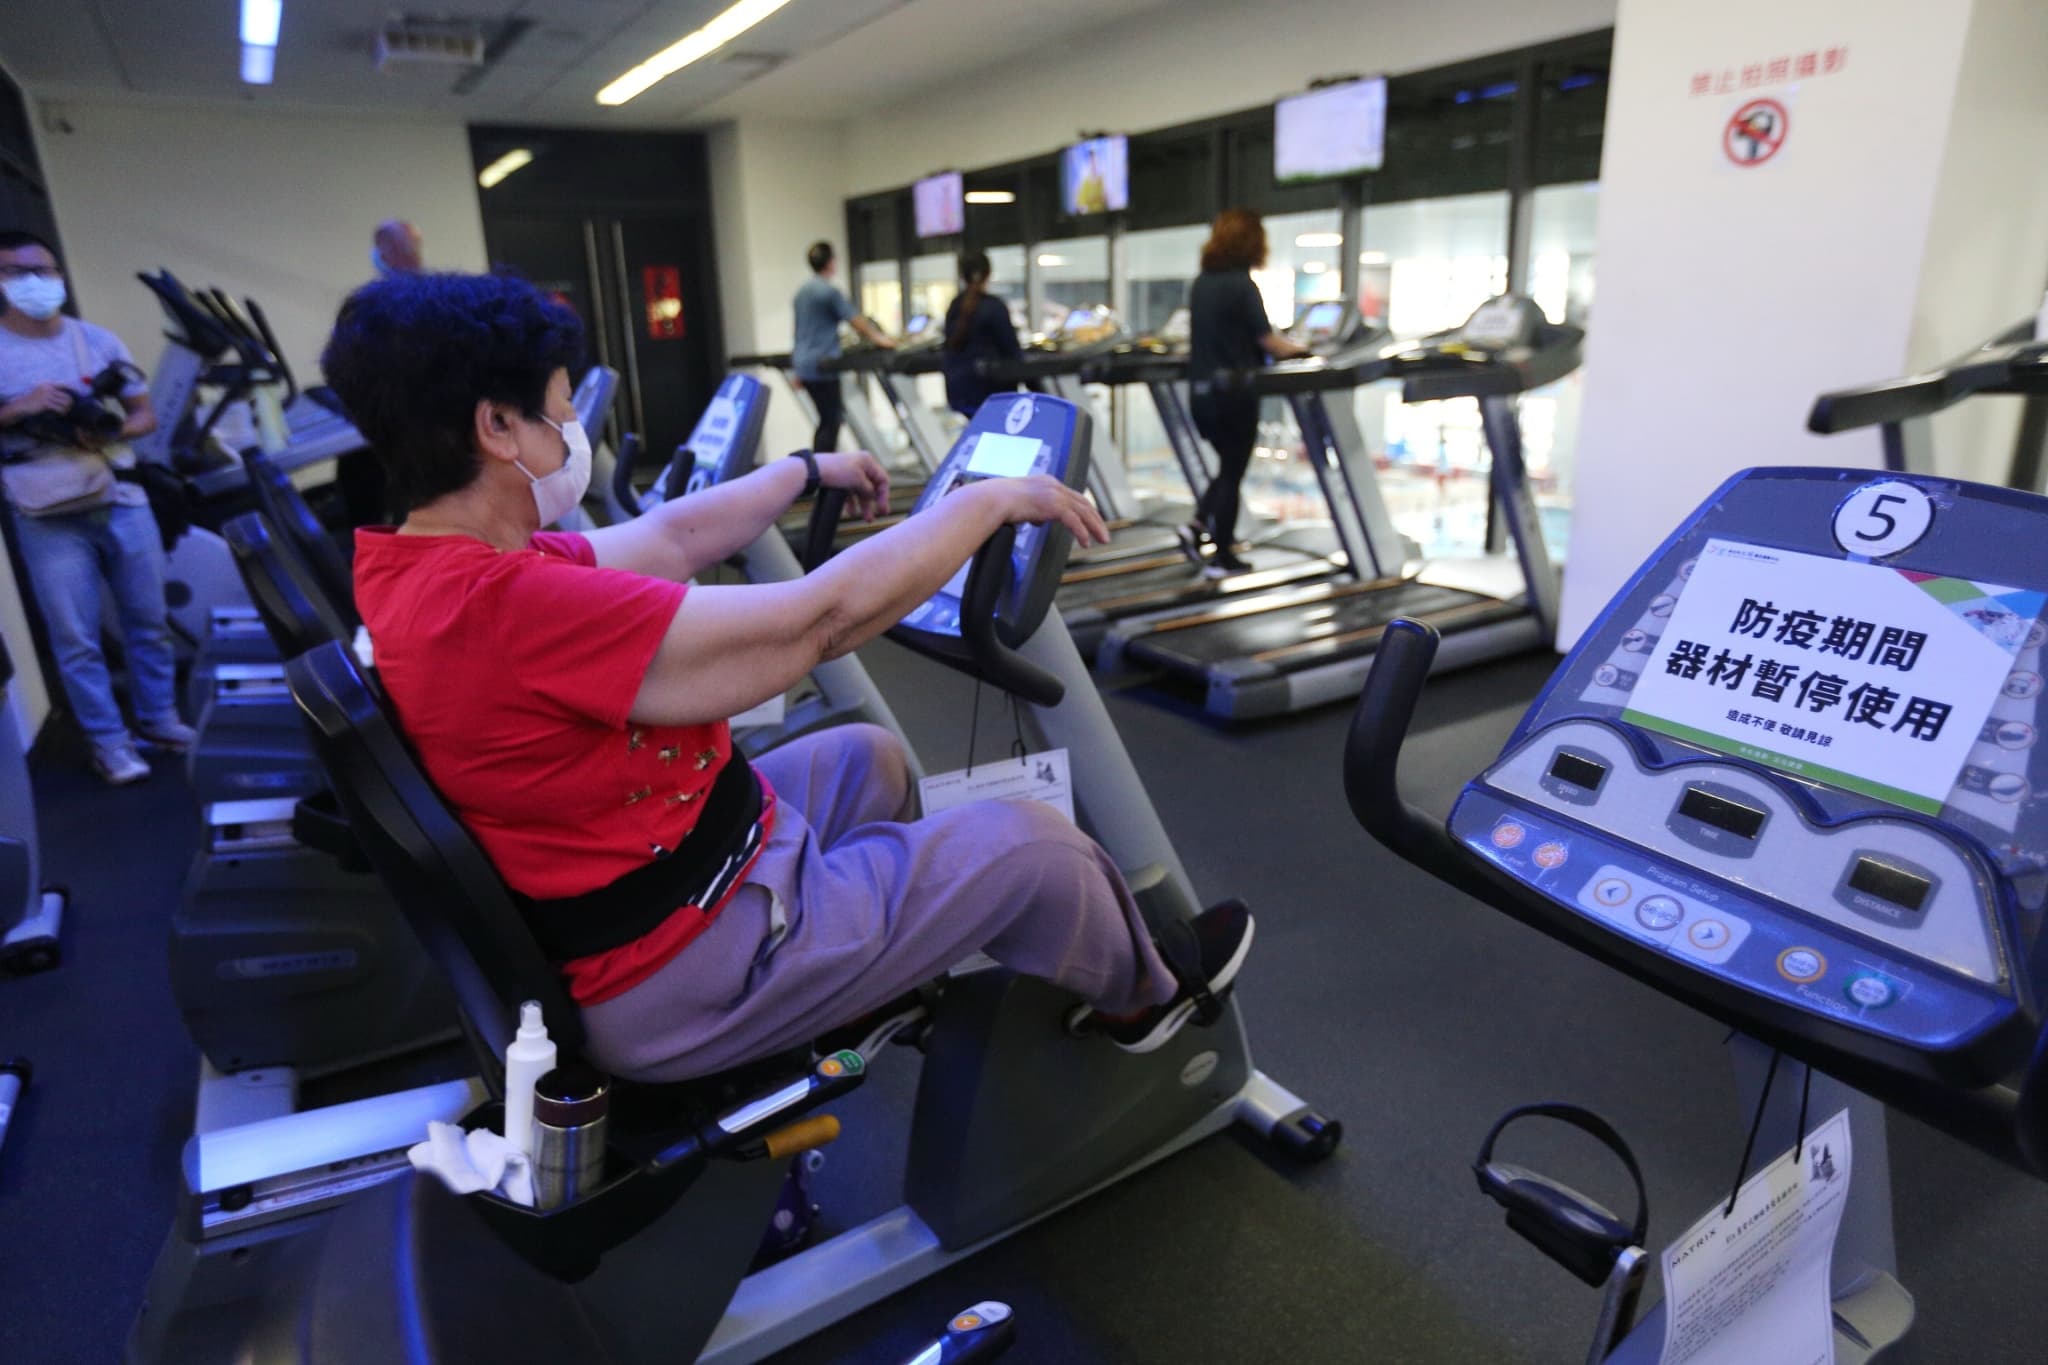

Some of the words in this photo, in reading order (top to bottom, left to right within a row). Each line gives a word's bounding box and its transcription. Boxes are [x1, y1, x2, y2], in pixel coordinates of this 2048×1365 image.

[1855, 494, 1907, 541] 5
[1729, 598, 1928, 672] 防疫期間
[1665, 640, 1953, 742] 器材暫停使用
[1726, 709, 1777, 732] 造成不便
[1779, 723, 1833, 747] 敬請見諒
[1796, 984, 1849, 1013] Function
[1671, 1227, 1716, 1268] MATRIX
